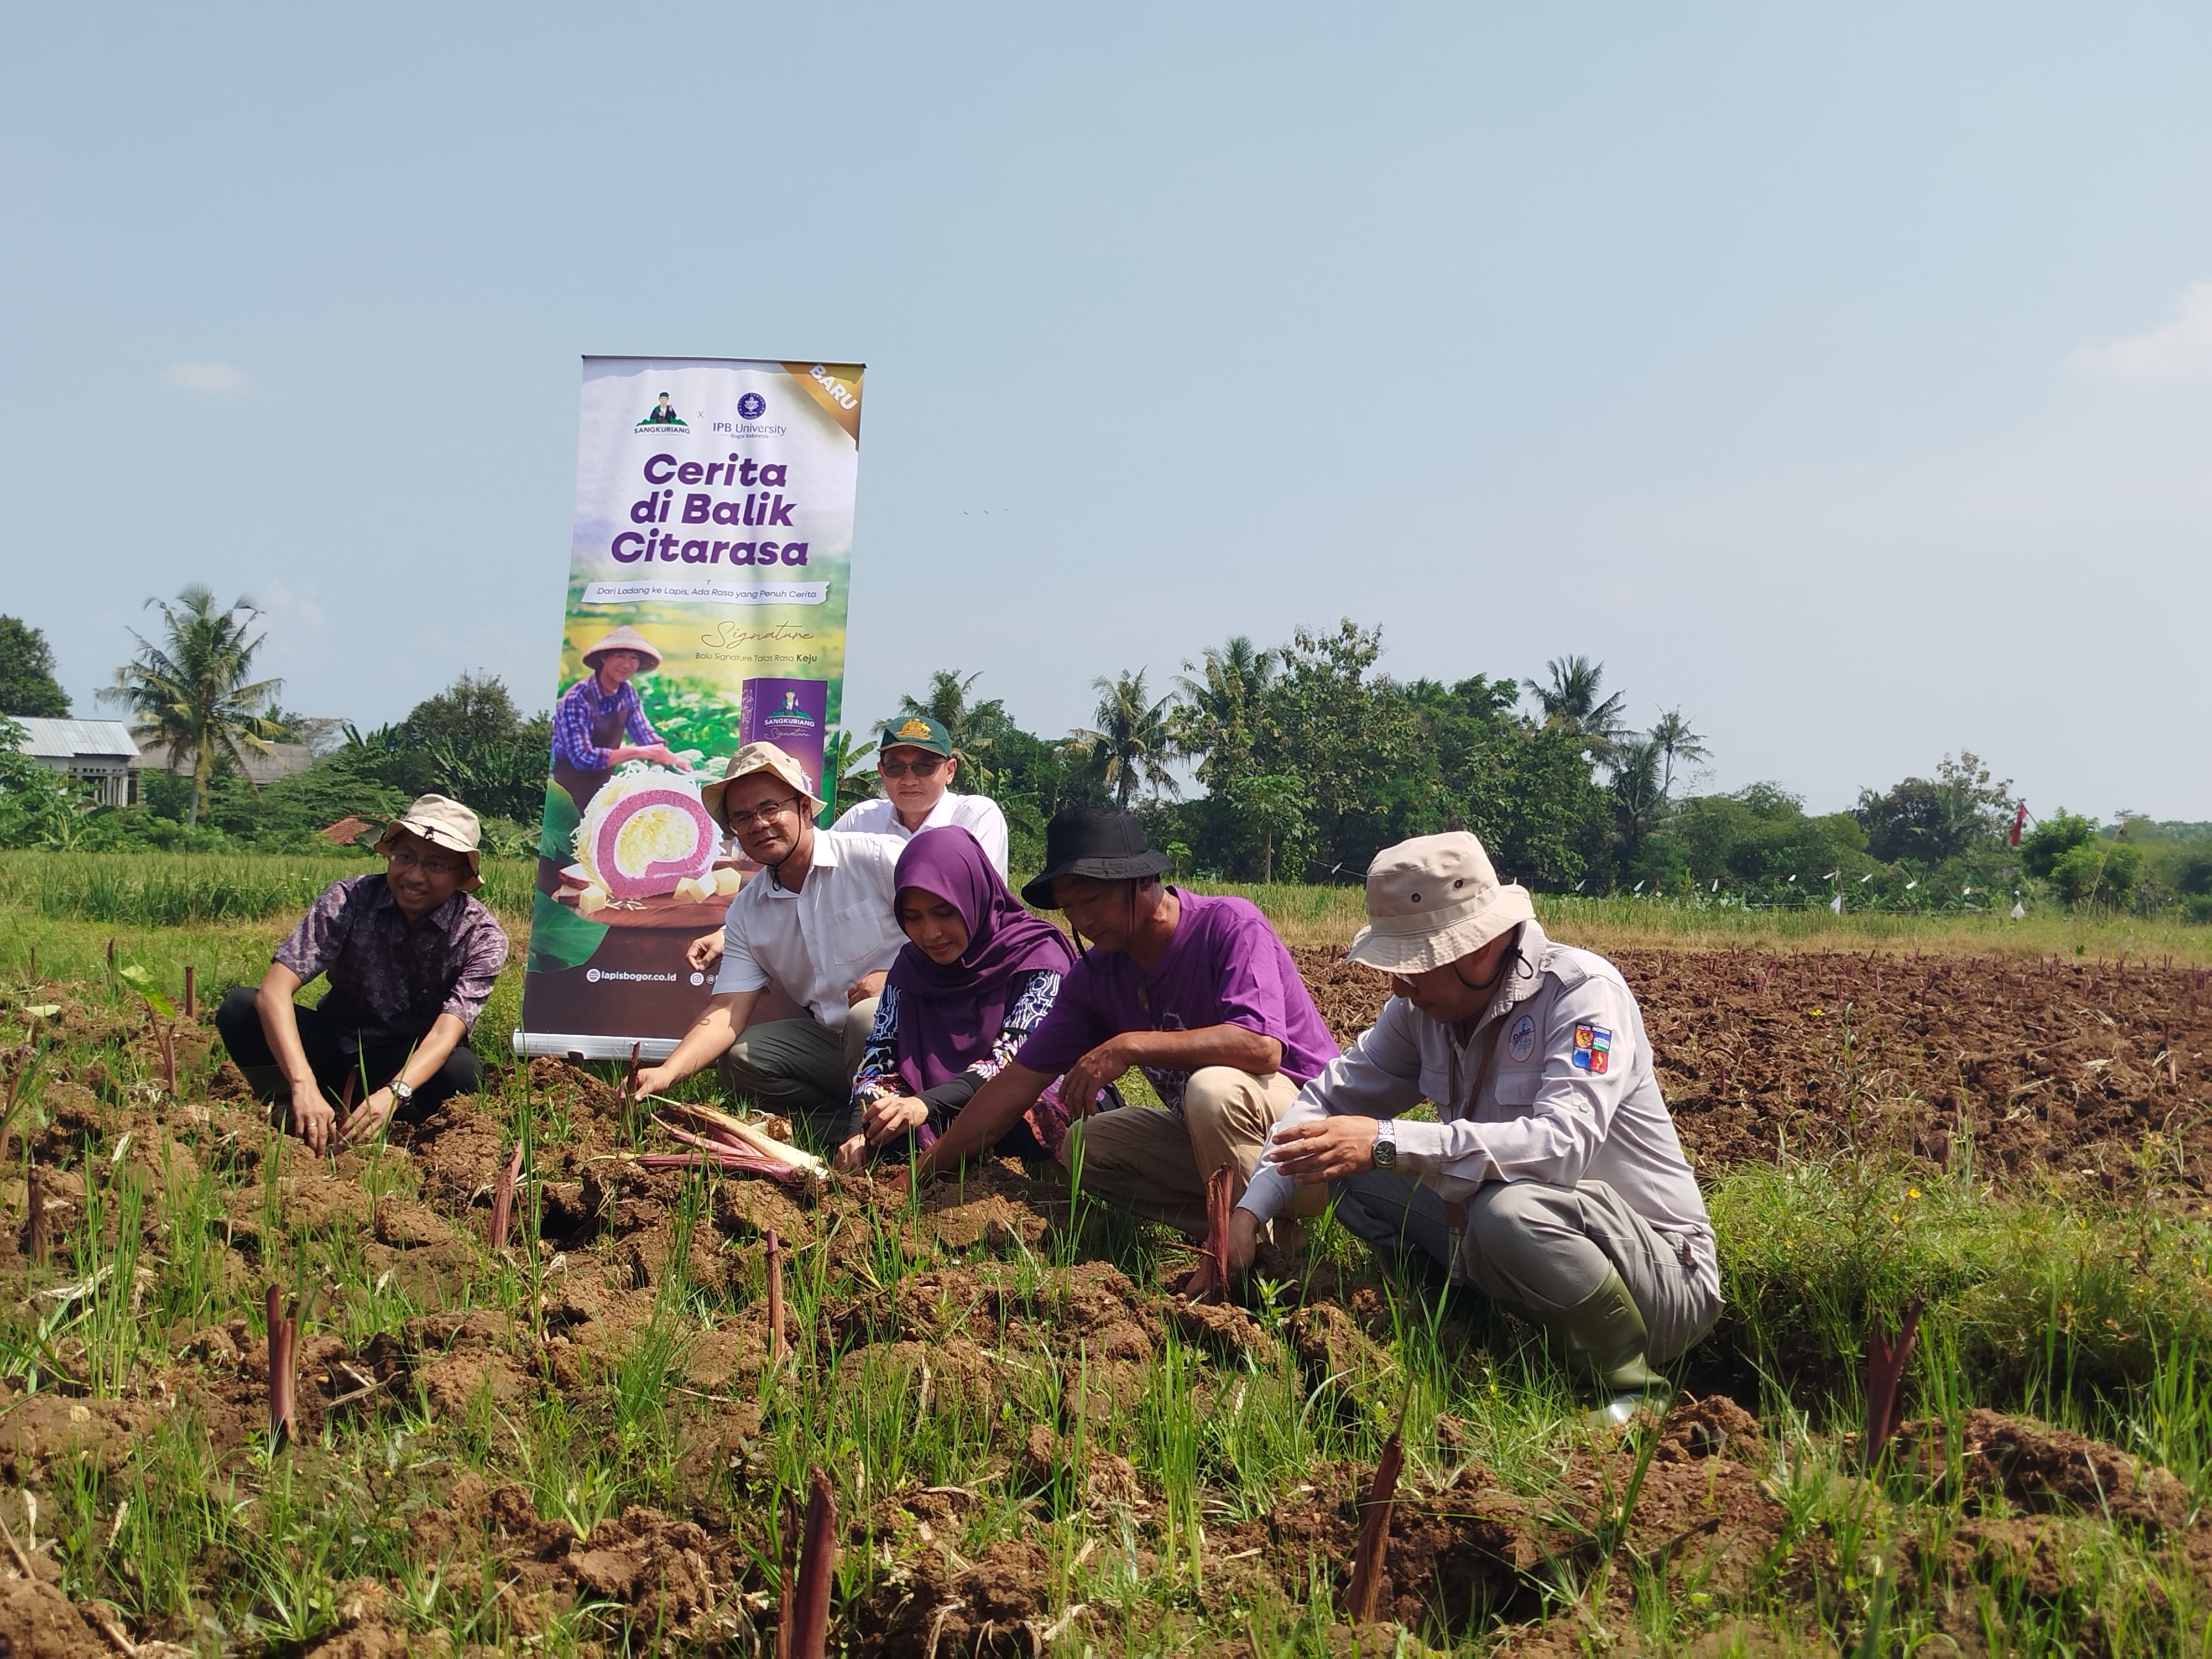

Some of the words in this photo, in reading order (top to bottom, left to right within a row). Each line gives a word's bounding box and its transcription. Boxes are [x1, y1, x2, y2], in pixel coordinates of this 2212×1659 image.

[809, 364, 858, 410] BARU
[713, 422, 732, 432] IPB
[735, 423, 787, 437] University
[644, 452, 787, 487] Cerita
[630, 489, 674, 524] di
[681, 491, 798, 526] Balik
[611, 528, 808, 566] Citarasa
[664, 587, 689, 596] Lapis,
[712, 588, 733, 597] Rasa
[701, 620, 814, 649] Signature
[714, 653, 752, 661] Signature
[796, 654, 817, 664] Keju
[764, 718, 815, 727] SANGKURIANG
[602, 971, 676, 982] lapisbogor.co.id
